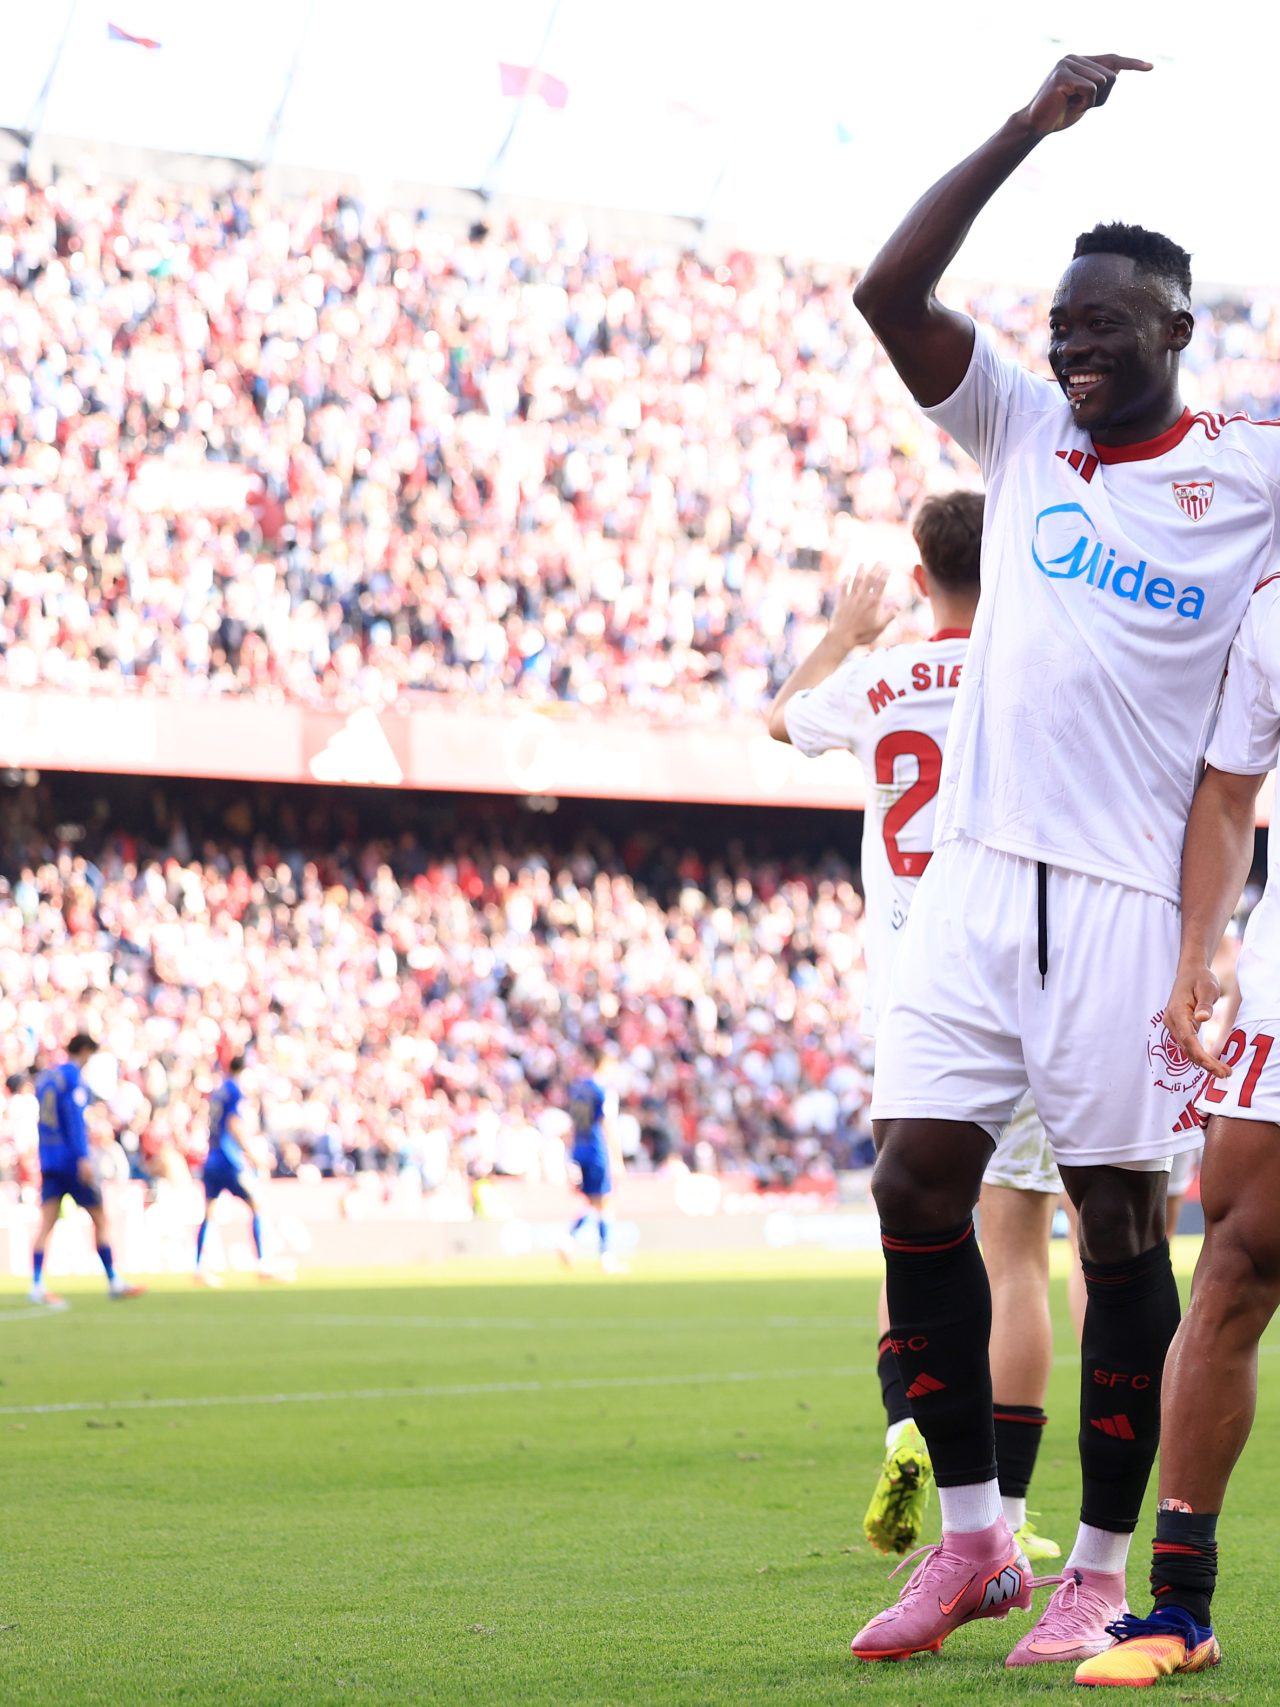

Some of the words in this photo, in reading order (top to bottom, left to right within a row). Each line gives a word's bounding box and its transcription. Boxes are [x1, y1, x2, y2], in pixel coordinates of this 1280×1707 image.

[1032, 502, 1206, 620] Midea
[867, 679, 906, 716] M.
[1205, 1029, 1275, 1108] 21
[1094, 1369, 1151, 1390] SFC
